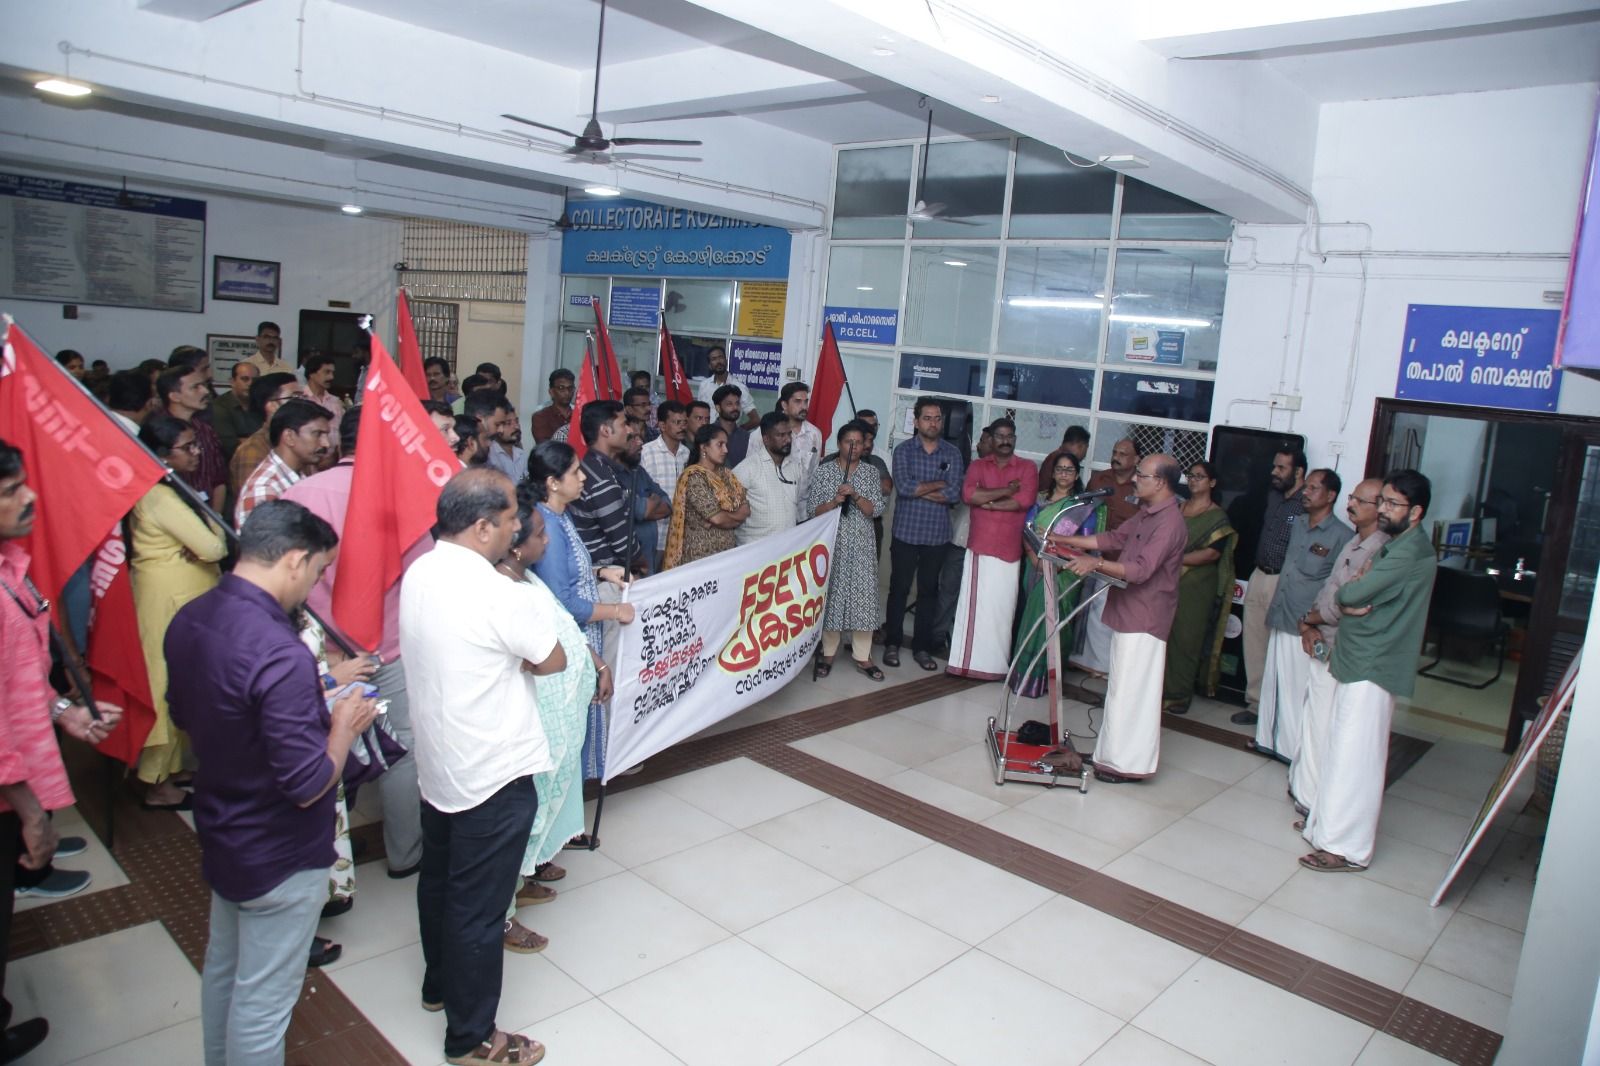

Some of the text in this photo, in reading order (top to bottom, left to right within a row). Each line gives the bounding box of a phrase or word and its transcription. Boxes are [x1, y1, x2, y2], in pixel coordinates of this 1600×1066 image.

[572, 206, 682, 231] COLLECTORATE
[663, 245, 772, 267] കോഴിക്കോട്
[571, 295, 600, 305] SERGEAT
[840, 327, 878, 338] P.G.CELL
[1406, 359, 1553, 389] തപാൽ സെക്ഷൻ
[740, 543, 830, 624] FSETO
